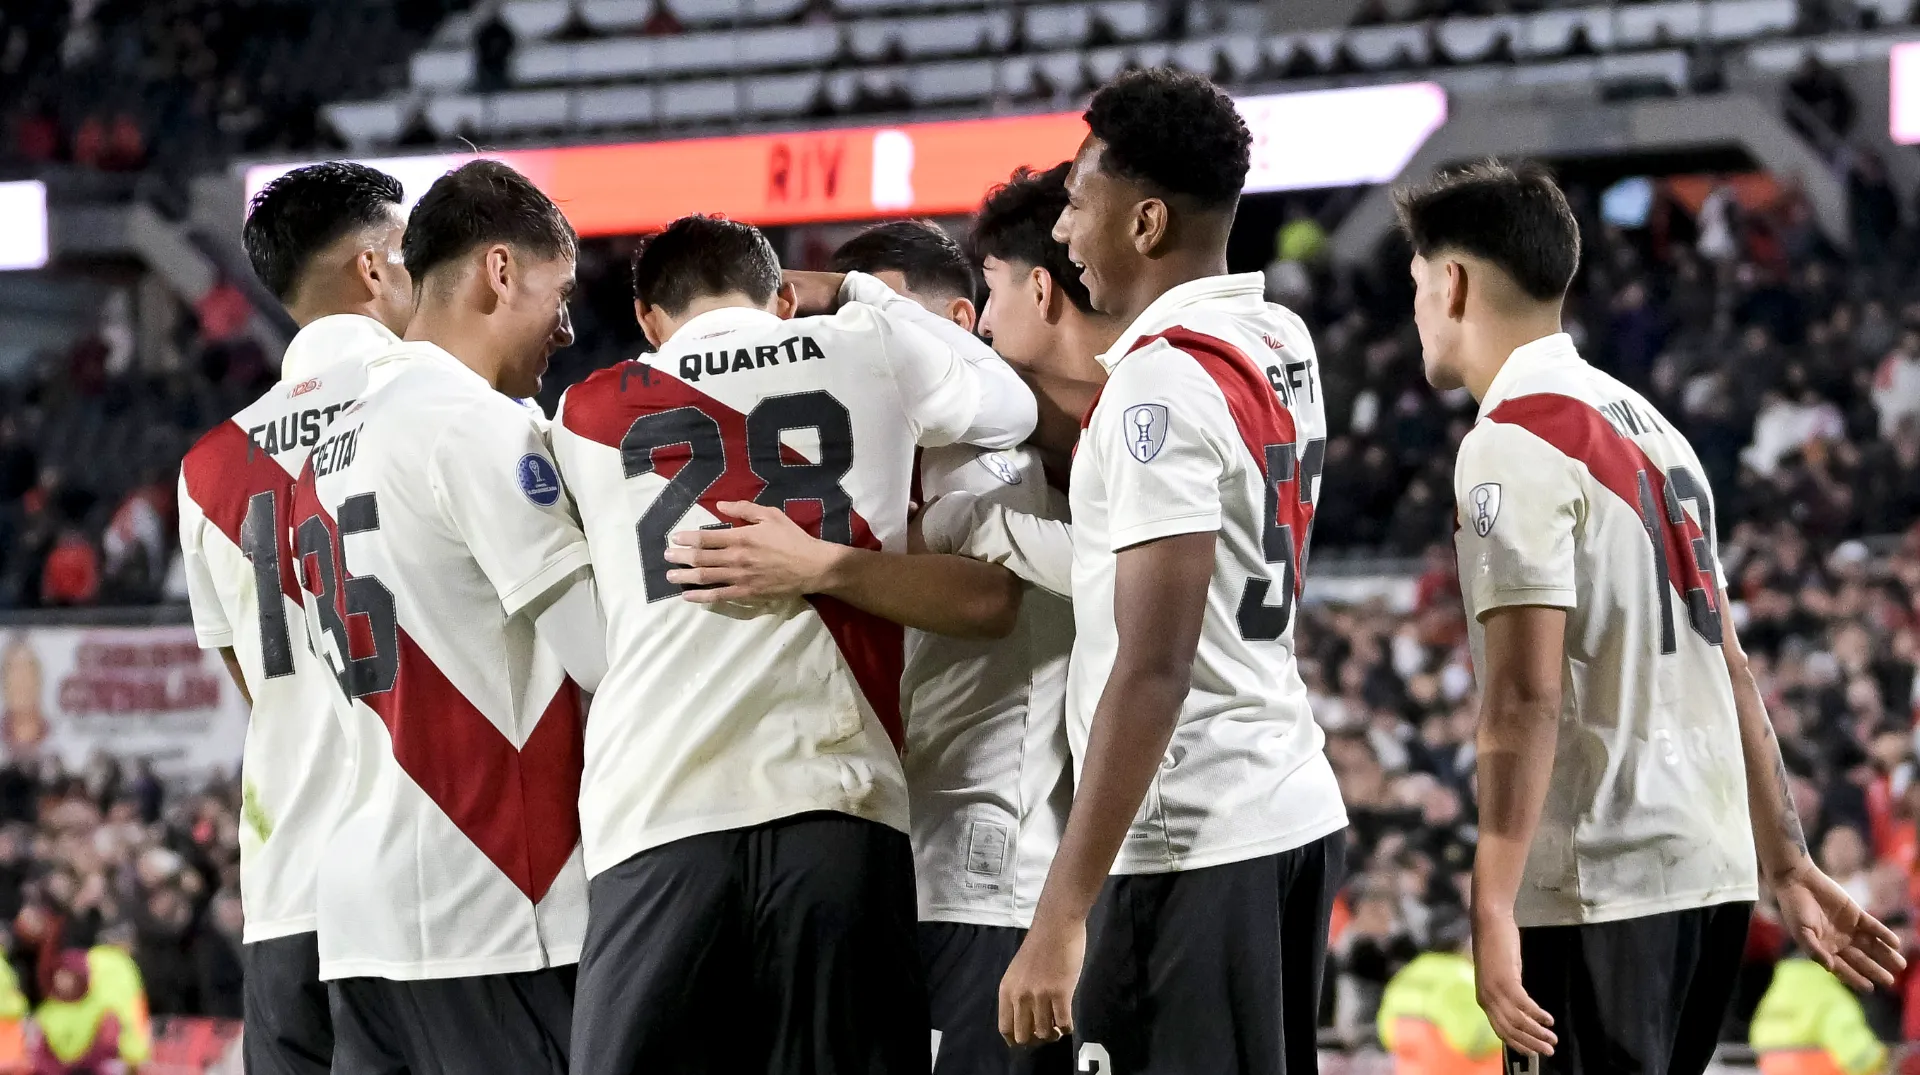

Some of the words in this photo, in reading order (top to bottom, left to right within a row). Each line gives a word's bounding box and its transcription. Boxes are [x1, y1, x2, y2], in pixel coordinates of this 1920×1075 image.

[679, 336, 825, 382] QUARTA
[247, 399, 357, 464] FAUST
[1140, 444, 1147, 457] 1
[620, 389, 854, 604] 28
[1637, 465, 1724, 655] 13
[297, 491, 400, 706] 35
